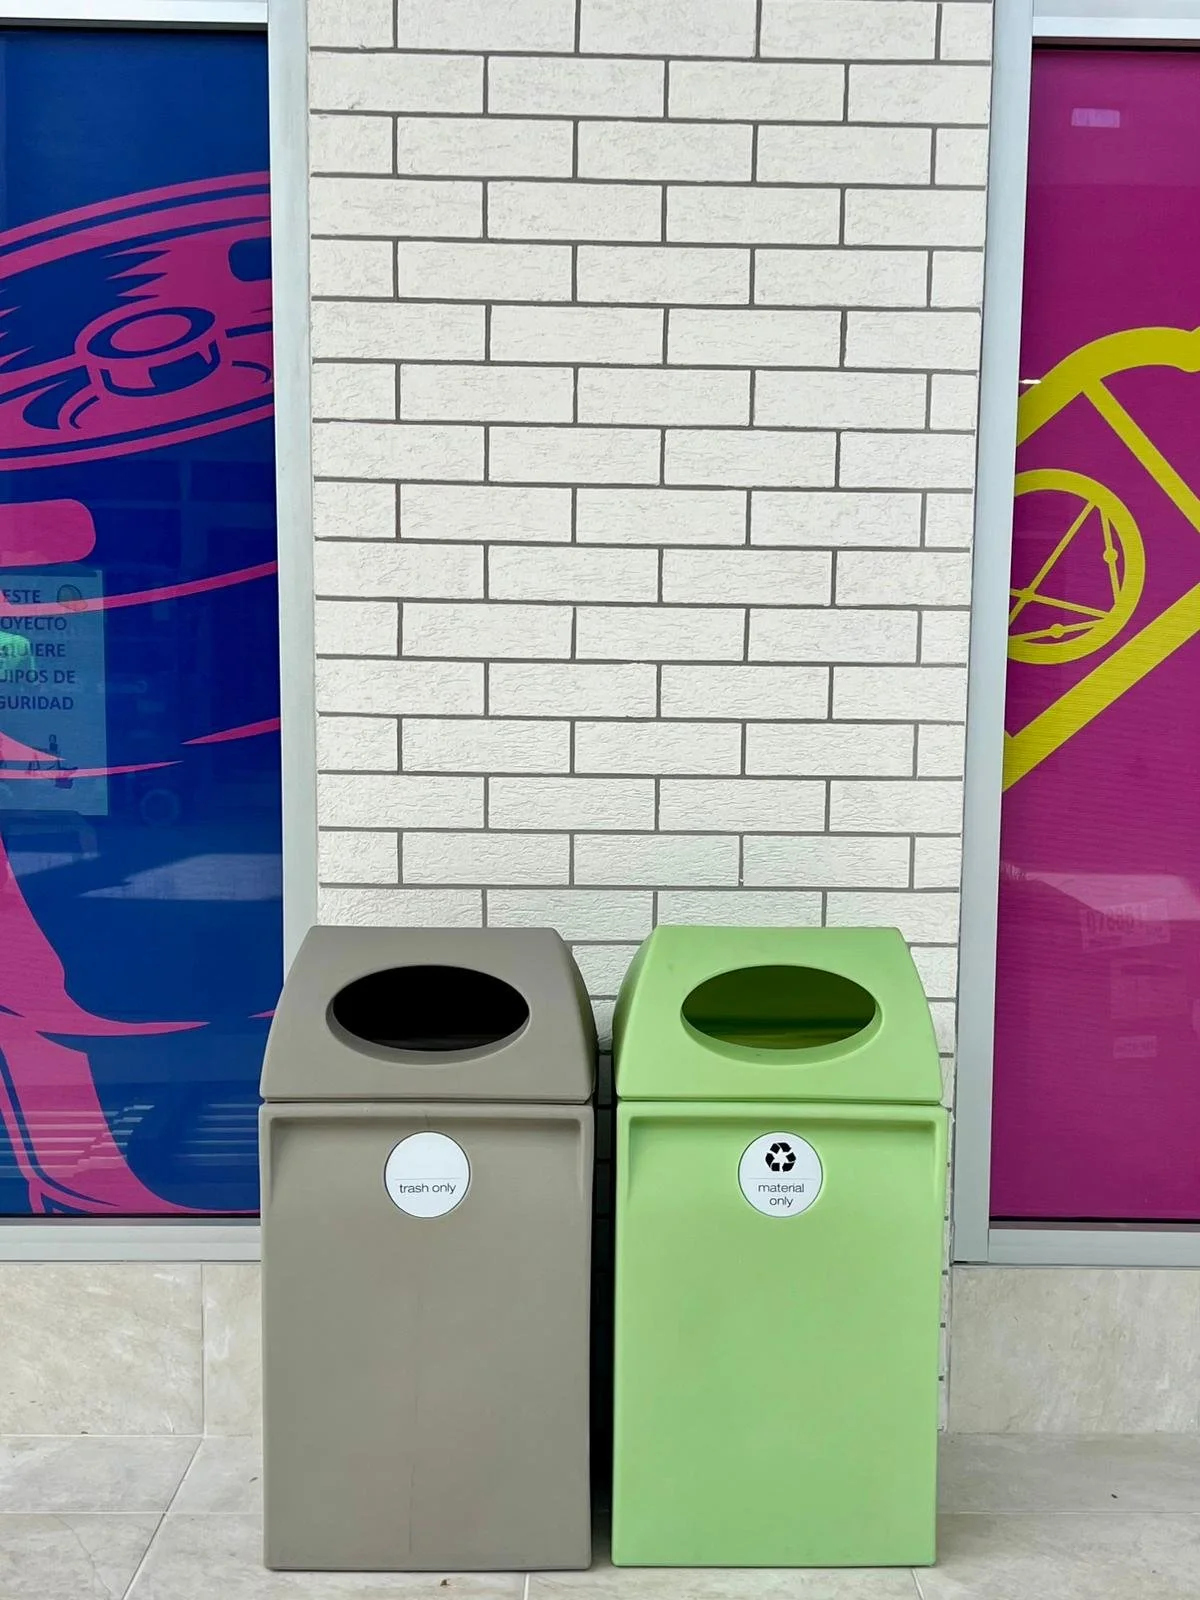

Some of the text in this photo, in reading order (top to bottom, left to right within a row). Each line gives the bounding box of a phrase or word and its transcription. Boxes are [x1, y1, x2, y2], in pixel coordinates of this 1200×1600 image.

[2, 589, 41, 604] ESTE
[0, 616, 67, 631] OYECTO
[54, 670, 76, 684] DE
[399, 1183, 456, 1195] trash only
[758, 1183, 805, 1193] material
[769, 1196, 794, 1208] only
